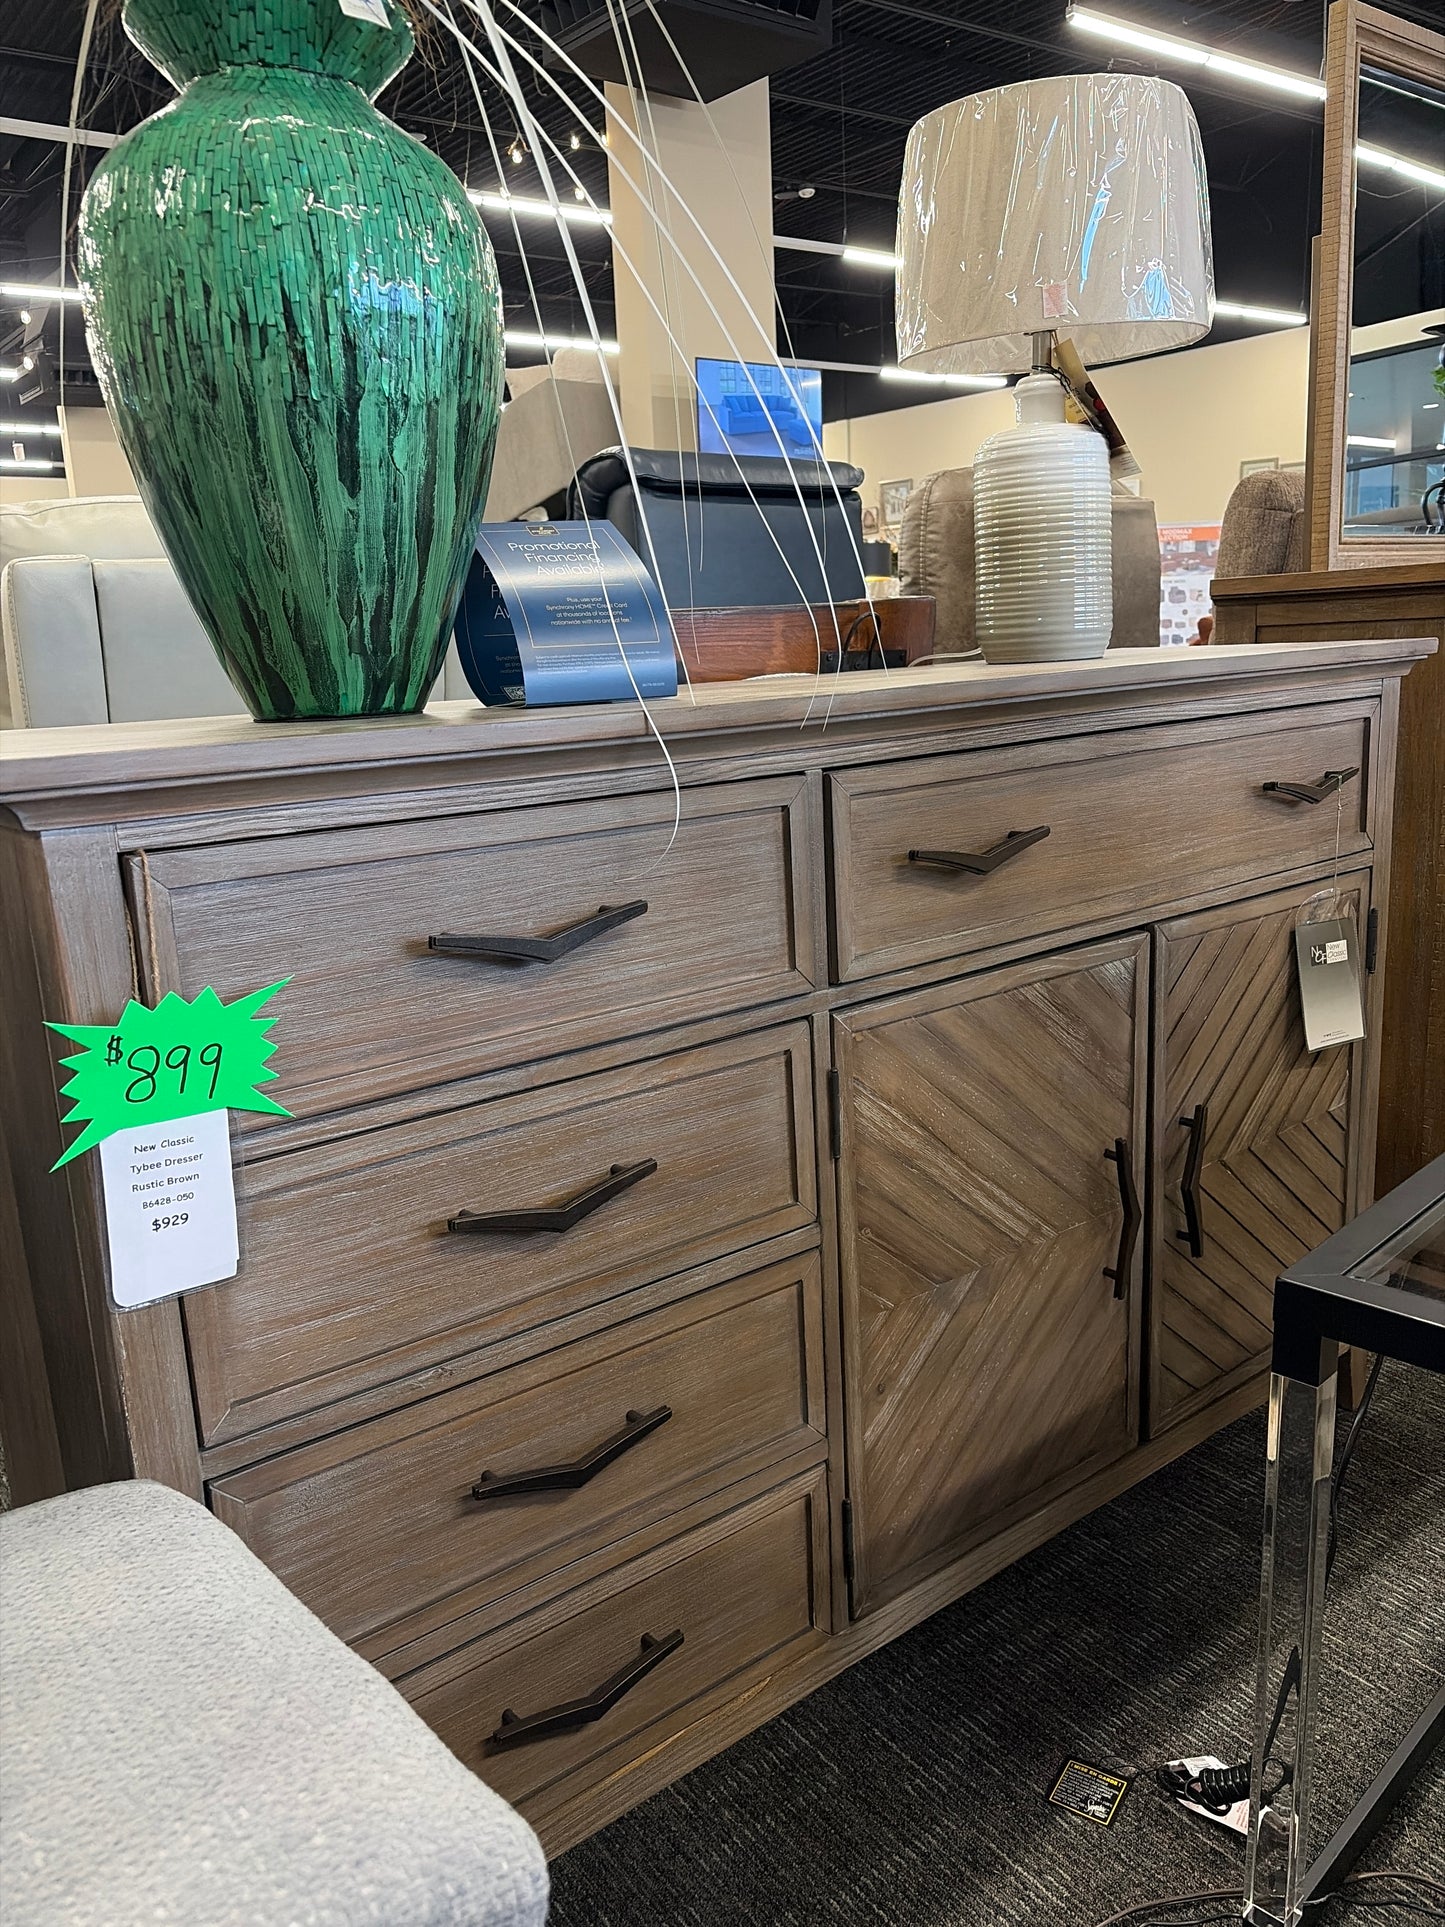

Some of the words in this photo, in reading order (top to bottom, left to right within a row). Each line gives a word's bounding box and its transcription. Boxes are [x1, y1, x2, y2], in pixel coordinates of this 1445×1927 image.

[507, 540, 601, 552] Promotional
[524, 552, 601, 563] Financing
[104, 1034, 223, 1103] $899
[133, 1143, 156, 1154] New
[160, 1135, 195, 1149] Classic
[130, 1160, 162, 1175] Tybee
[164, 1152, 203, 1168] Dresser
[132, 1178, 165, 1193] Rustic
[167, 1172, 200, 1186] Brown
[142, 1192, 195, 1210] B6428-050
[152, 1212, 189, 1232] $929
